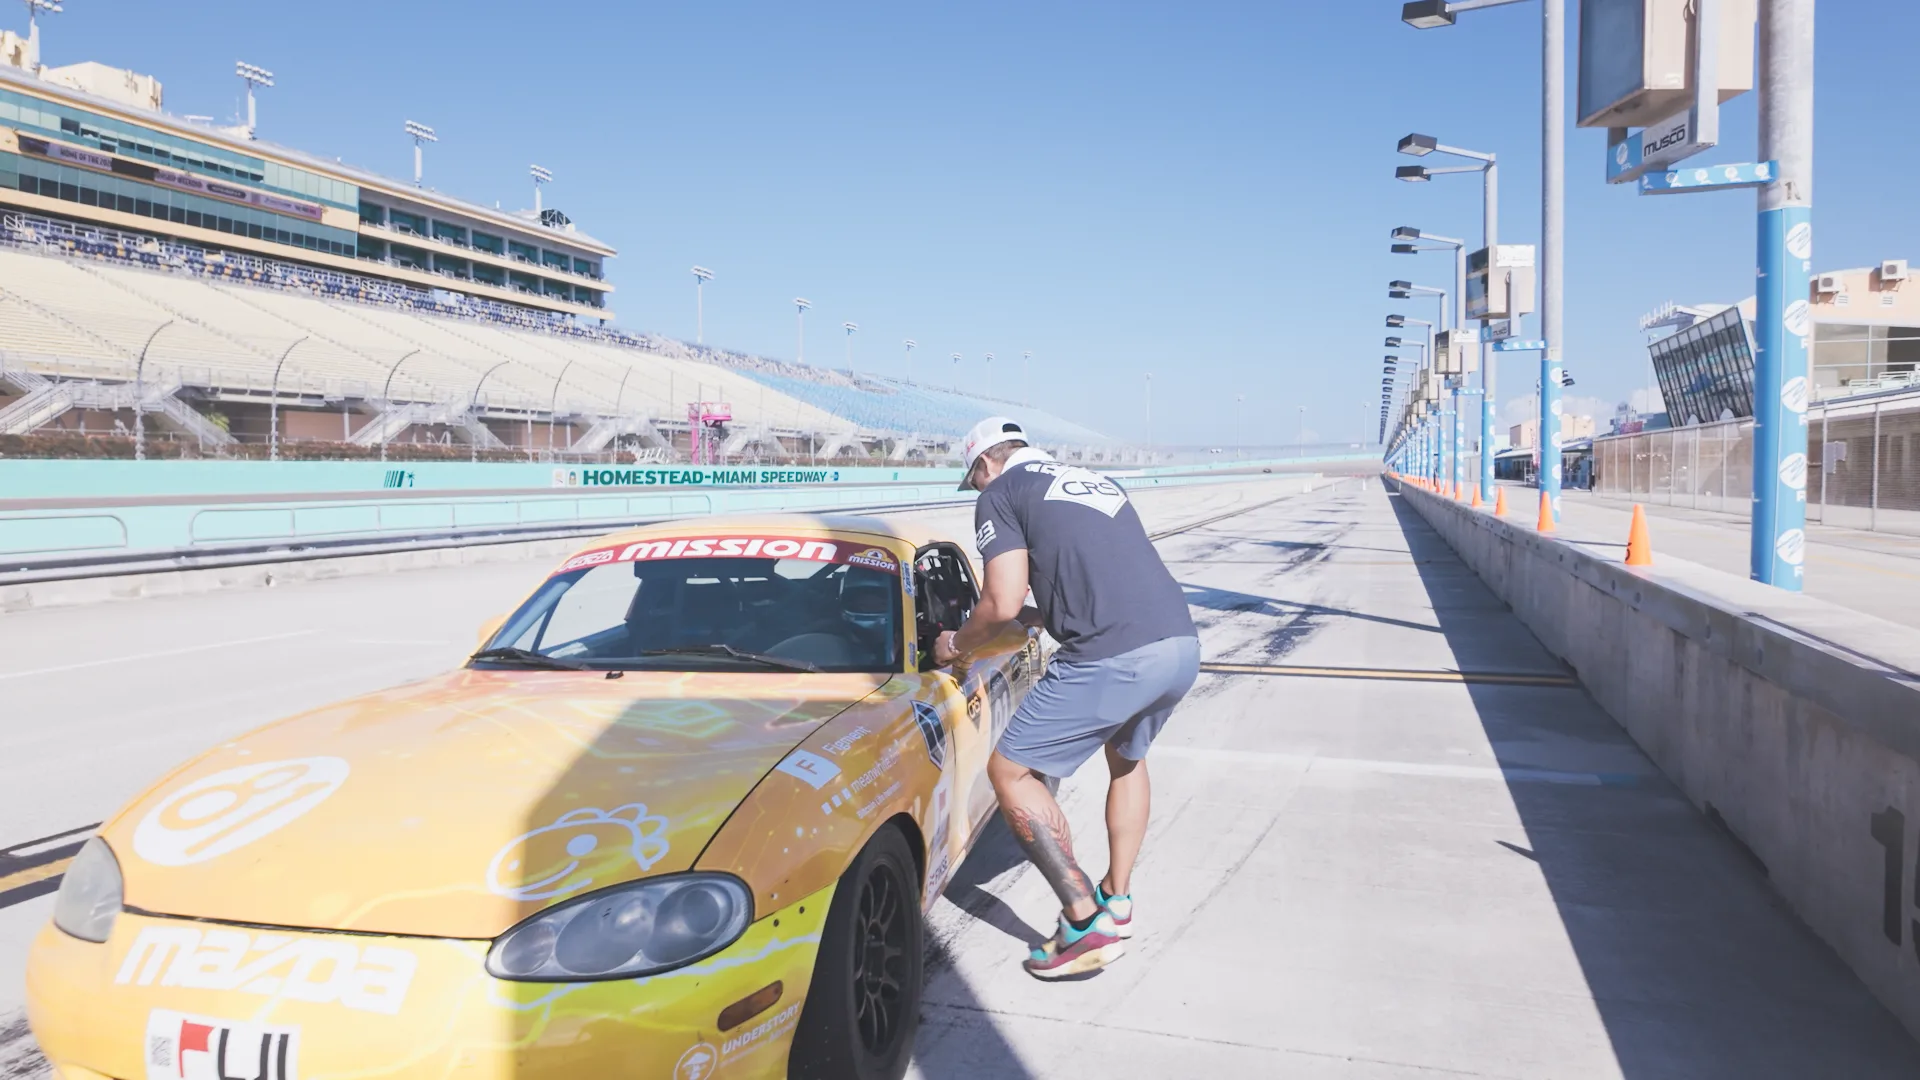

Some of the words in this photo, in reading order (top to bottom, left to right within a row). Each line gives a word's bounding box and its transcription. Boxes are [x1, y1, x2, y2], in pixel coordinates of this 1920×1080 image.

[1643, 128, 1686, 157] MUSCO
[60, 148, 78, 160] HOME
[79, 152, 87, 161] OF
[87, 154, 99, 165] THE
[583, 470, 756, 485] HOMESTEAD-MIAMI
[761, 471, 827, 483] SPEEDWAY
[1061, 480, 1119, 496] CRS
[822, 725, 871, 755] Figment
[795, 759, 818, 775] F
[722, 1001, 800, 1055] UNDERSTORY
